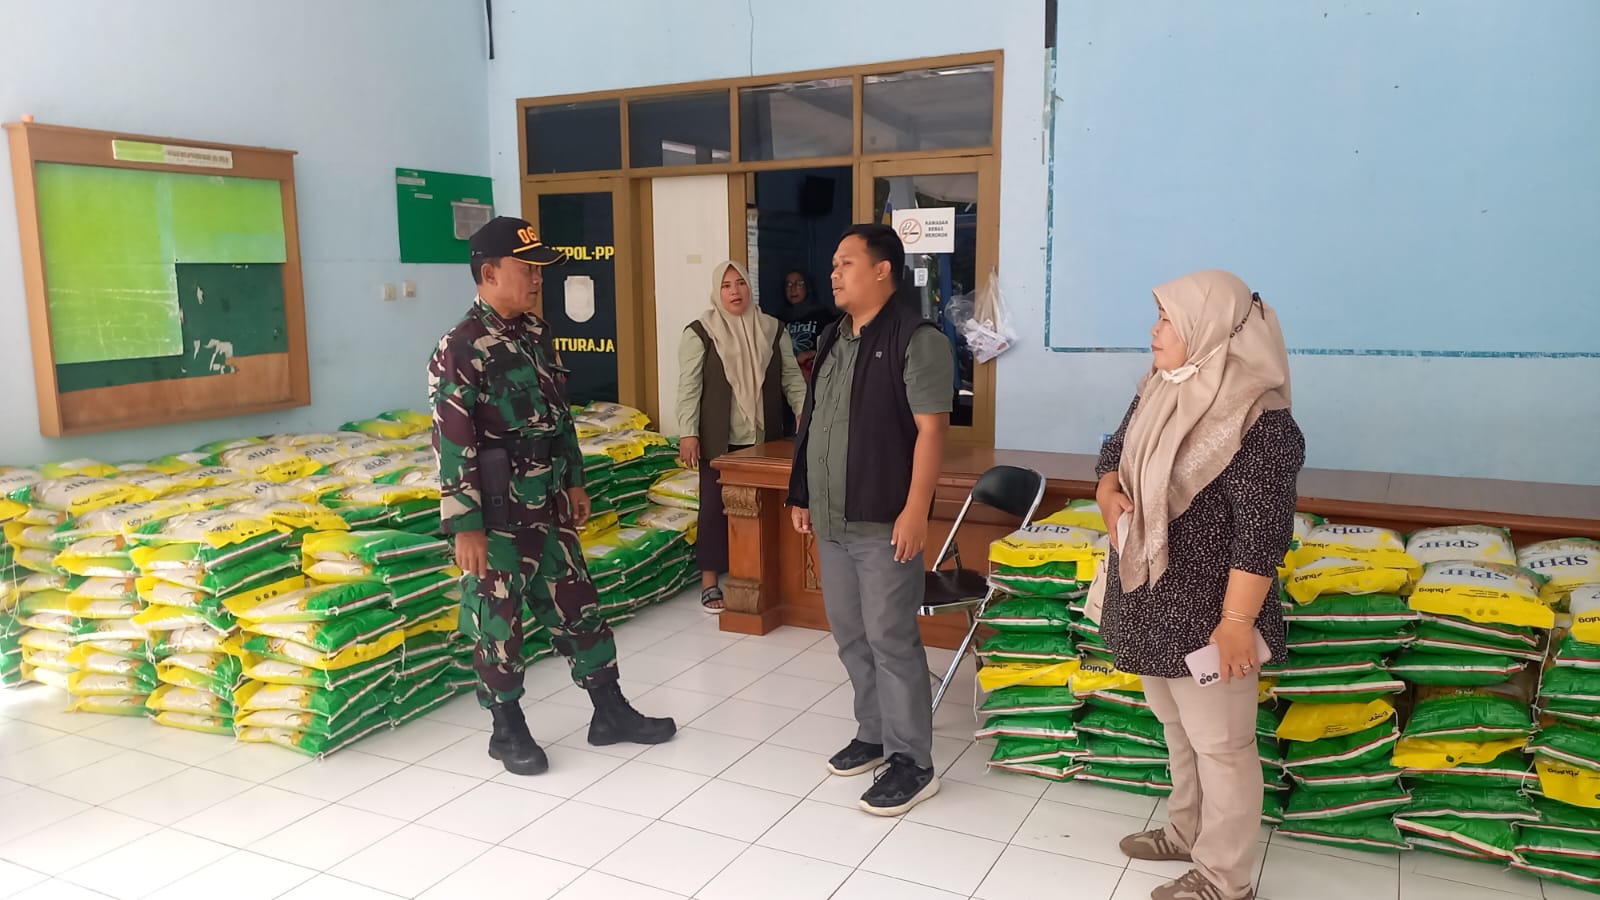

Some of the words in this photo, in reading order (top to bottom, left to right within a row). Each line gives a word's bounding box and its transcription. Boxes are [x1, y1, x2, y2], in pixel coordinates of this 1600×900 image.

[553, 337, 615, 353] ITURAJA
[1440, 568, 1509, 581] SPHP
[1080, 664, 1108, 676] bulog
